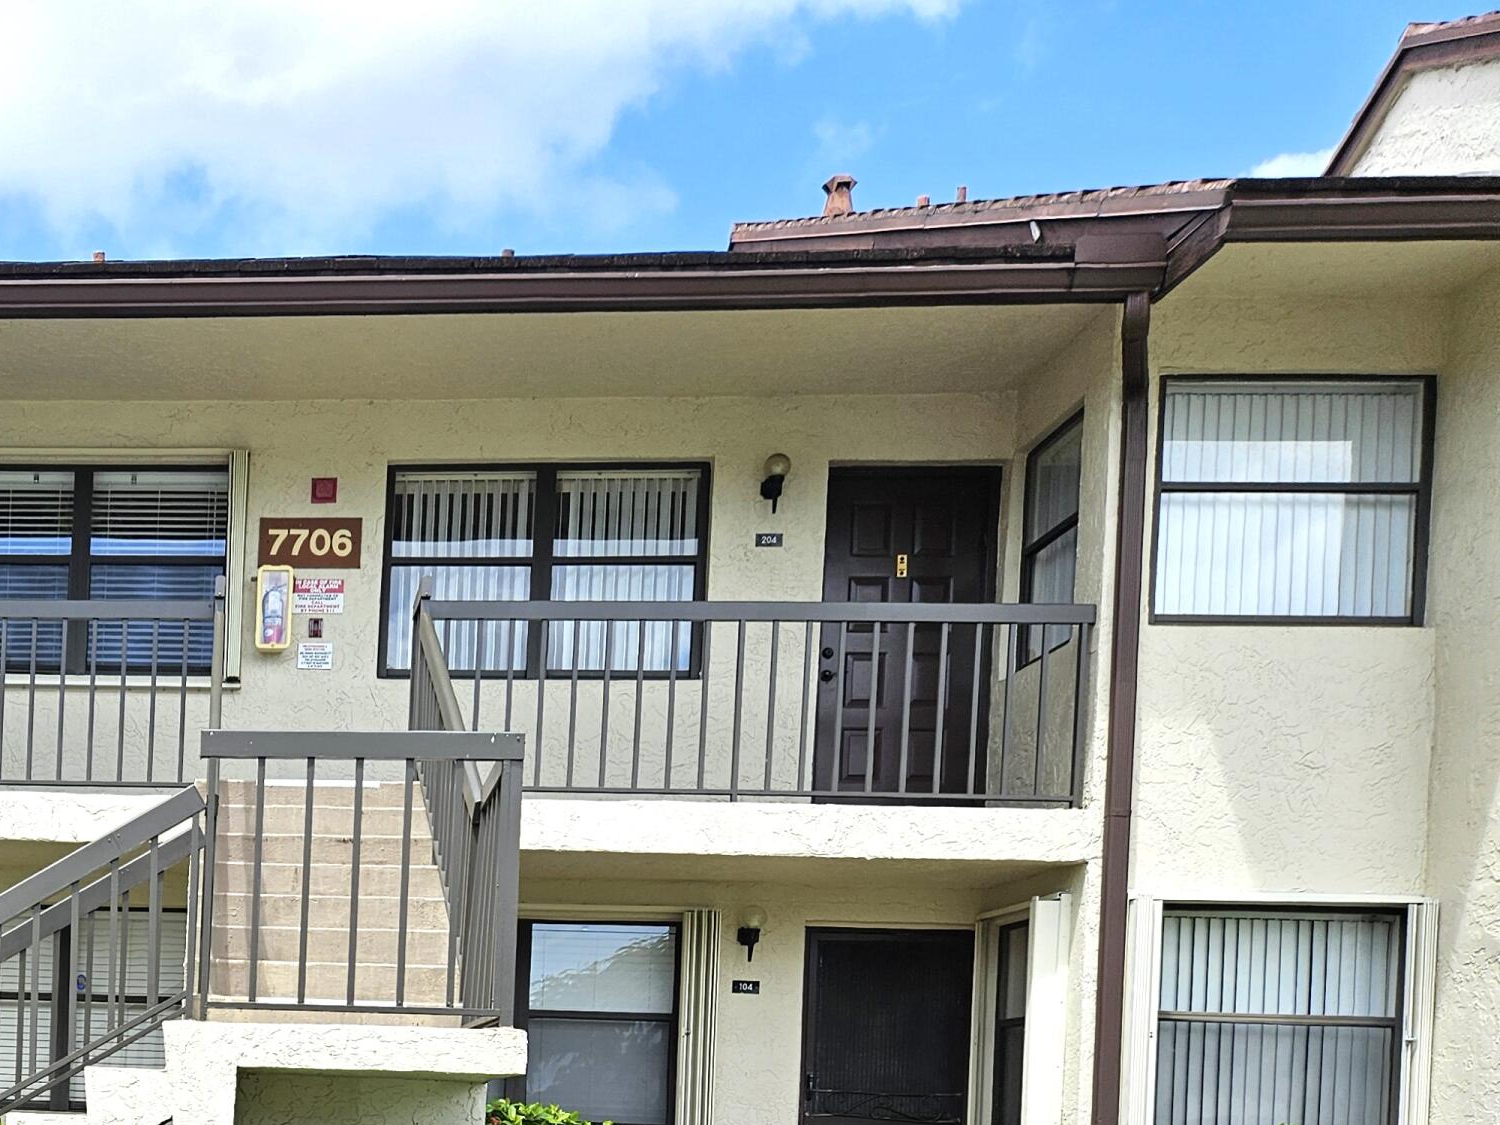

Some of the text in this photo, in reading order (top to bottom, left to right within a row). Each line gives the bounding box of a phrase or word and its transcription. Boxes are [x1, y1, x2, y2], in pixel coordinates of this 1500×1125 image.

[267, 528, 353, 557] 7706
[760, 535, 777, 544] 204
[739, 982, 753, 991] 104
